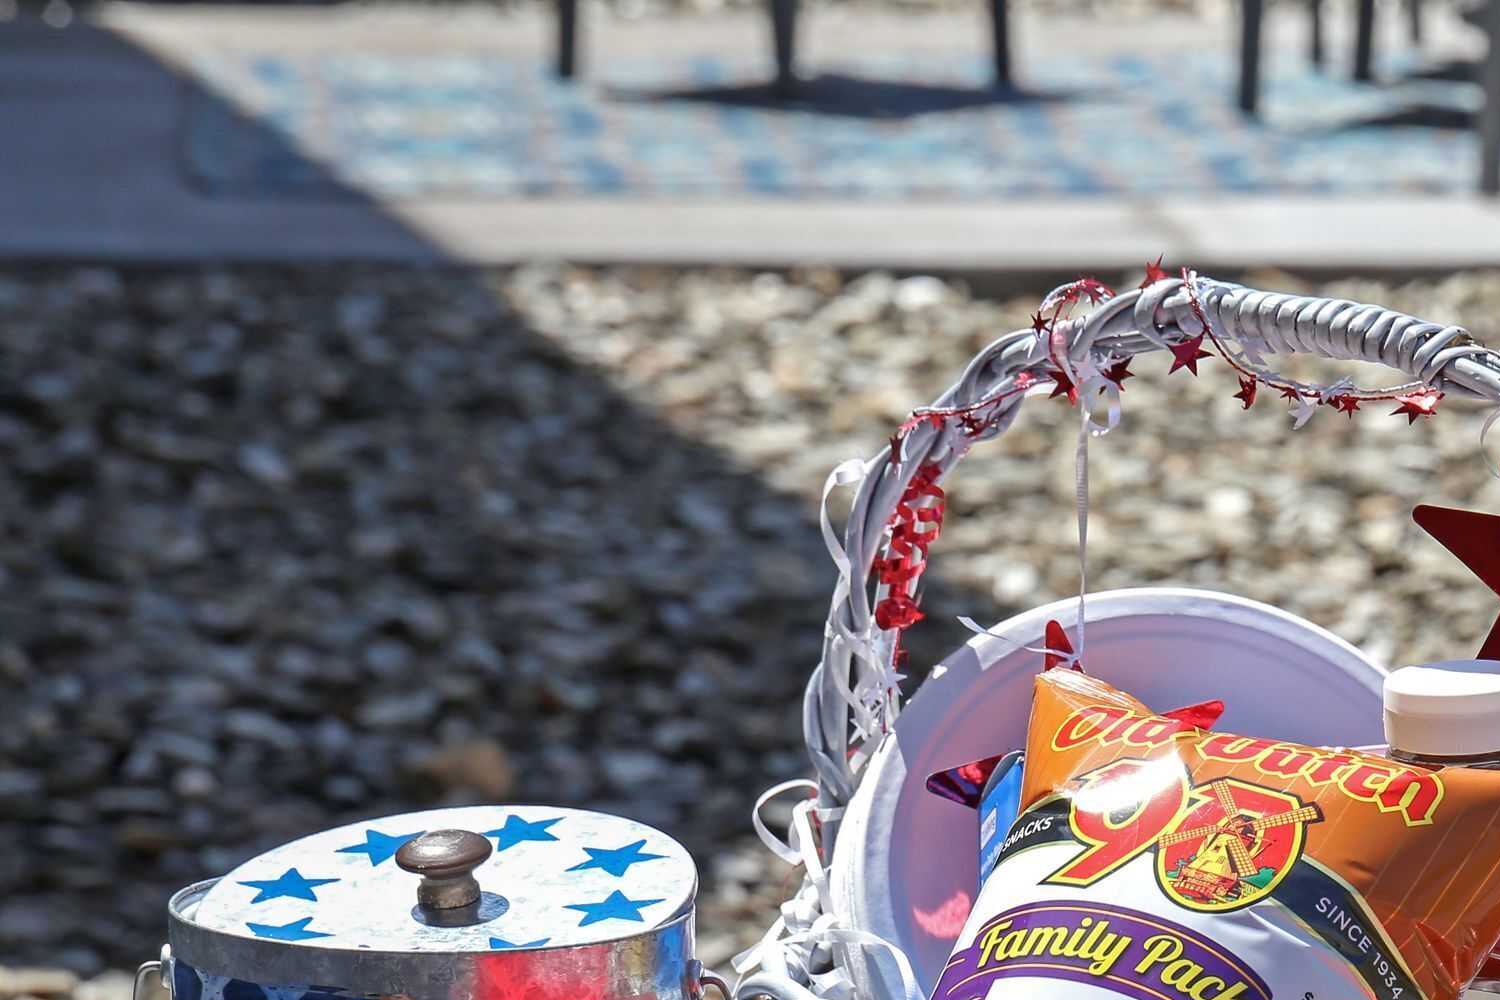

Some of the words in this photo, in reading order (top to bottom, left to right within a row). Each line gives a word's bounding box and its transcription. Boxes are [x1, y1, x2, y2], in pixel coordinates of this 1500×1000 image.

[1051, 704, 1199, 752] Old
[1195, 733, 1445, 827] Dutch
[1003, 817, 1054, 851] SNACKS
[977, 917, 1133, 976] Family
[1315, 897, 1373, 954] SINCE
[1371, 952, 1404, 1000] 1934
